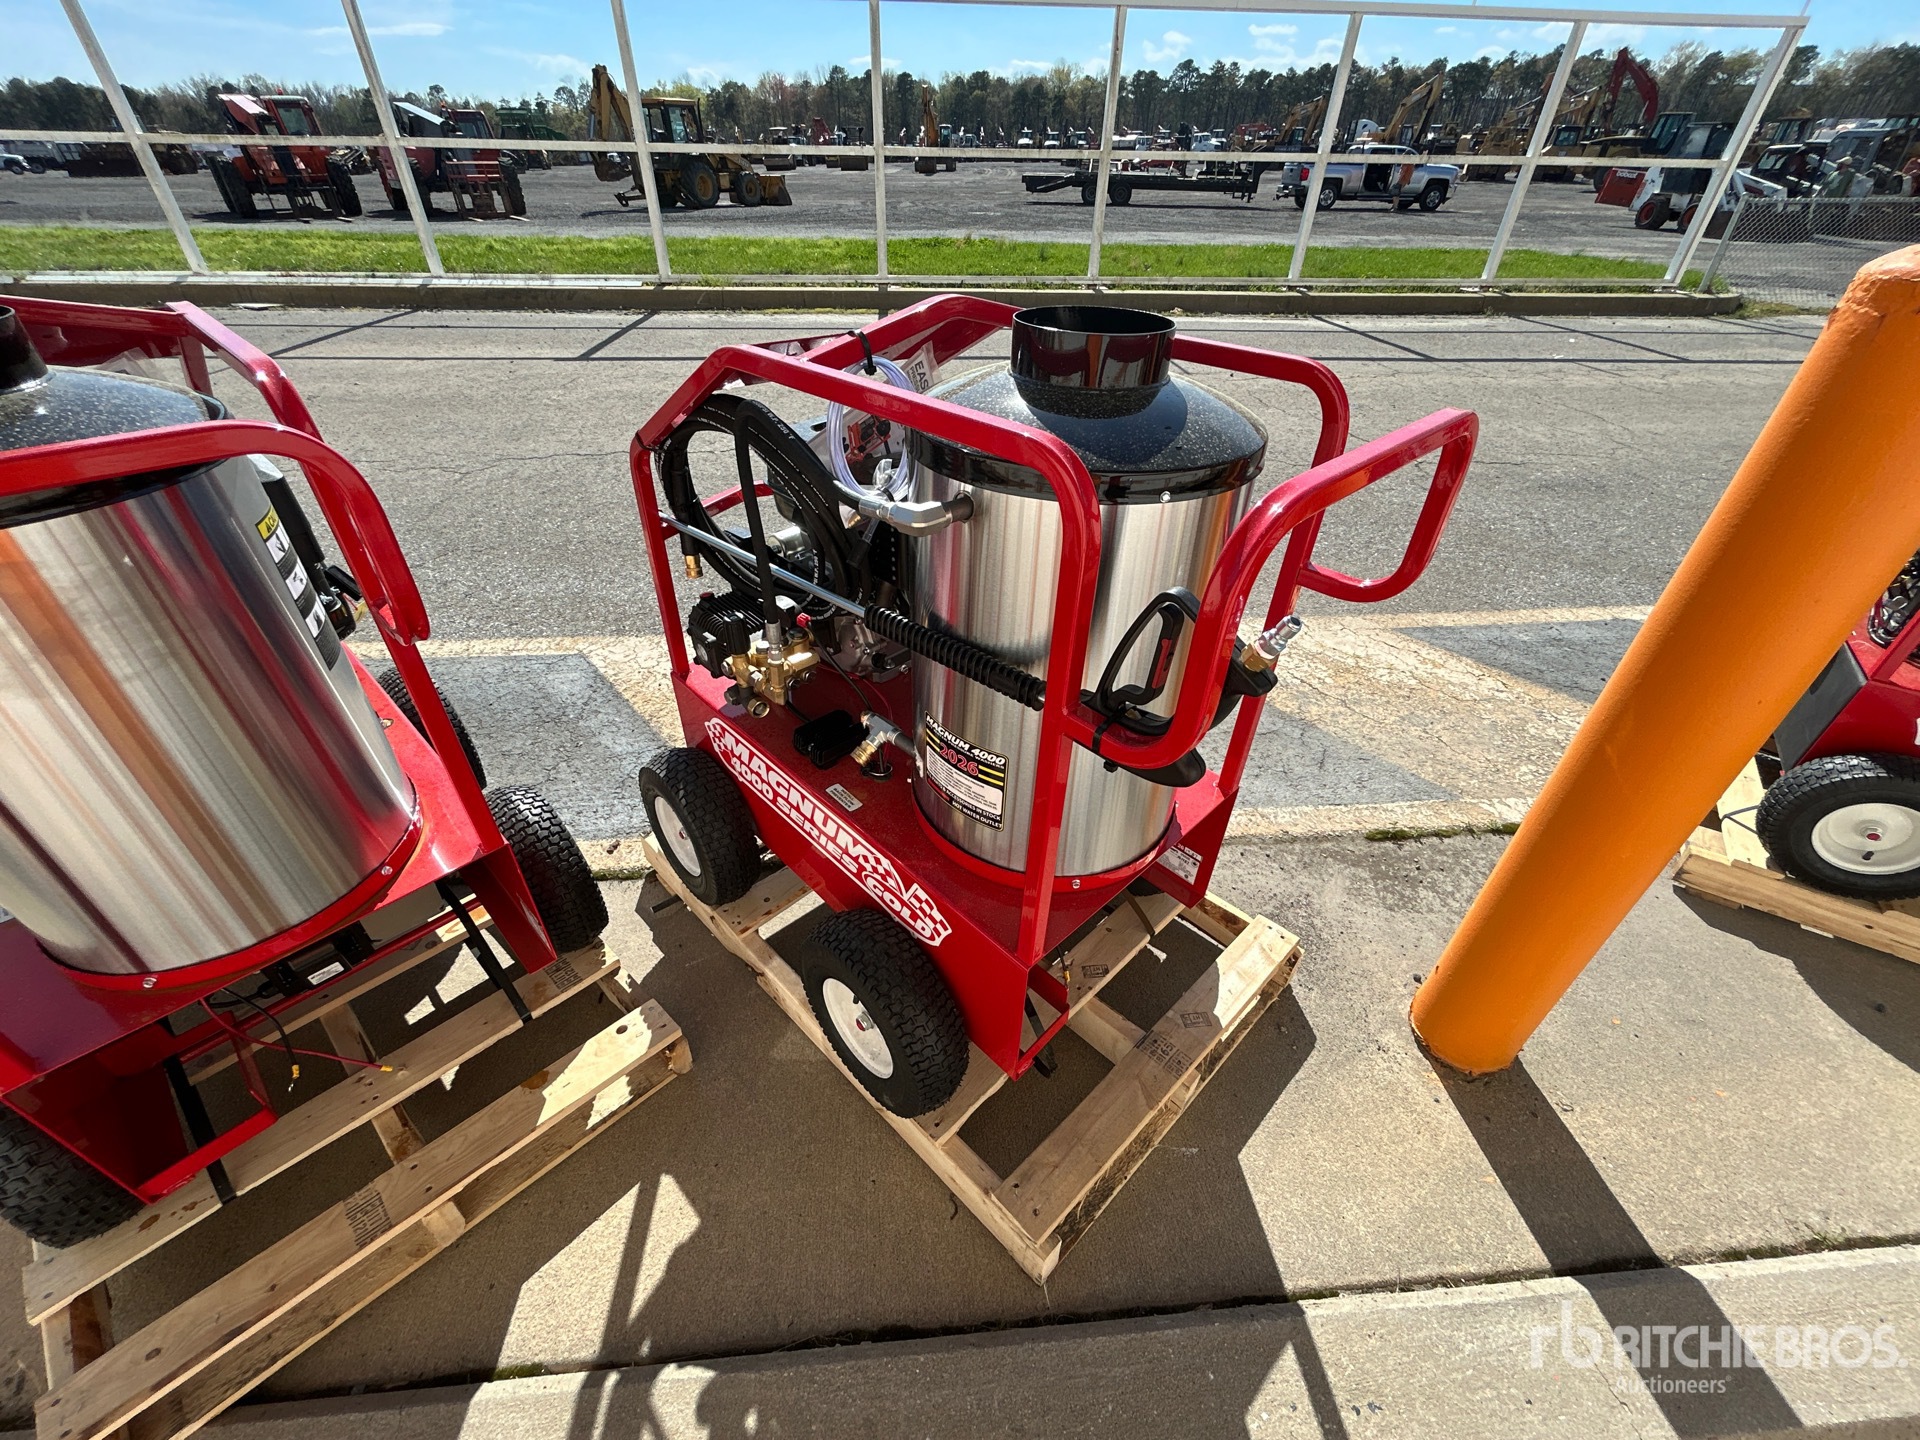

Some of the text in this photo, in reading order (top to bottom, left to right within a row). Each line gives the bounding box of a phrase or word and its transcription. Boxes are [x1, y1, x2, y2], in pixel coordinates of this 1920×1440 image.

[926, 715, 1006, 765] MAGNUM 4000
[939, 742, 979, 776] 2026
[722, 731, 870, 869] MAGNUM
[731, 755, 860, 874] 4000 SERIES
[946, 789, 976, 811] ACCESSORIES
[982, 810, 1001, 821] STOCK
[951, 800, 1002, 829] HOT WATER OUTLET
[865, 875, 933, 939] GOLD
